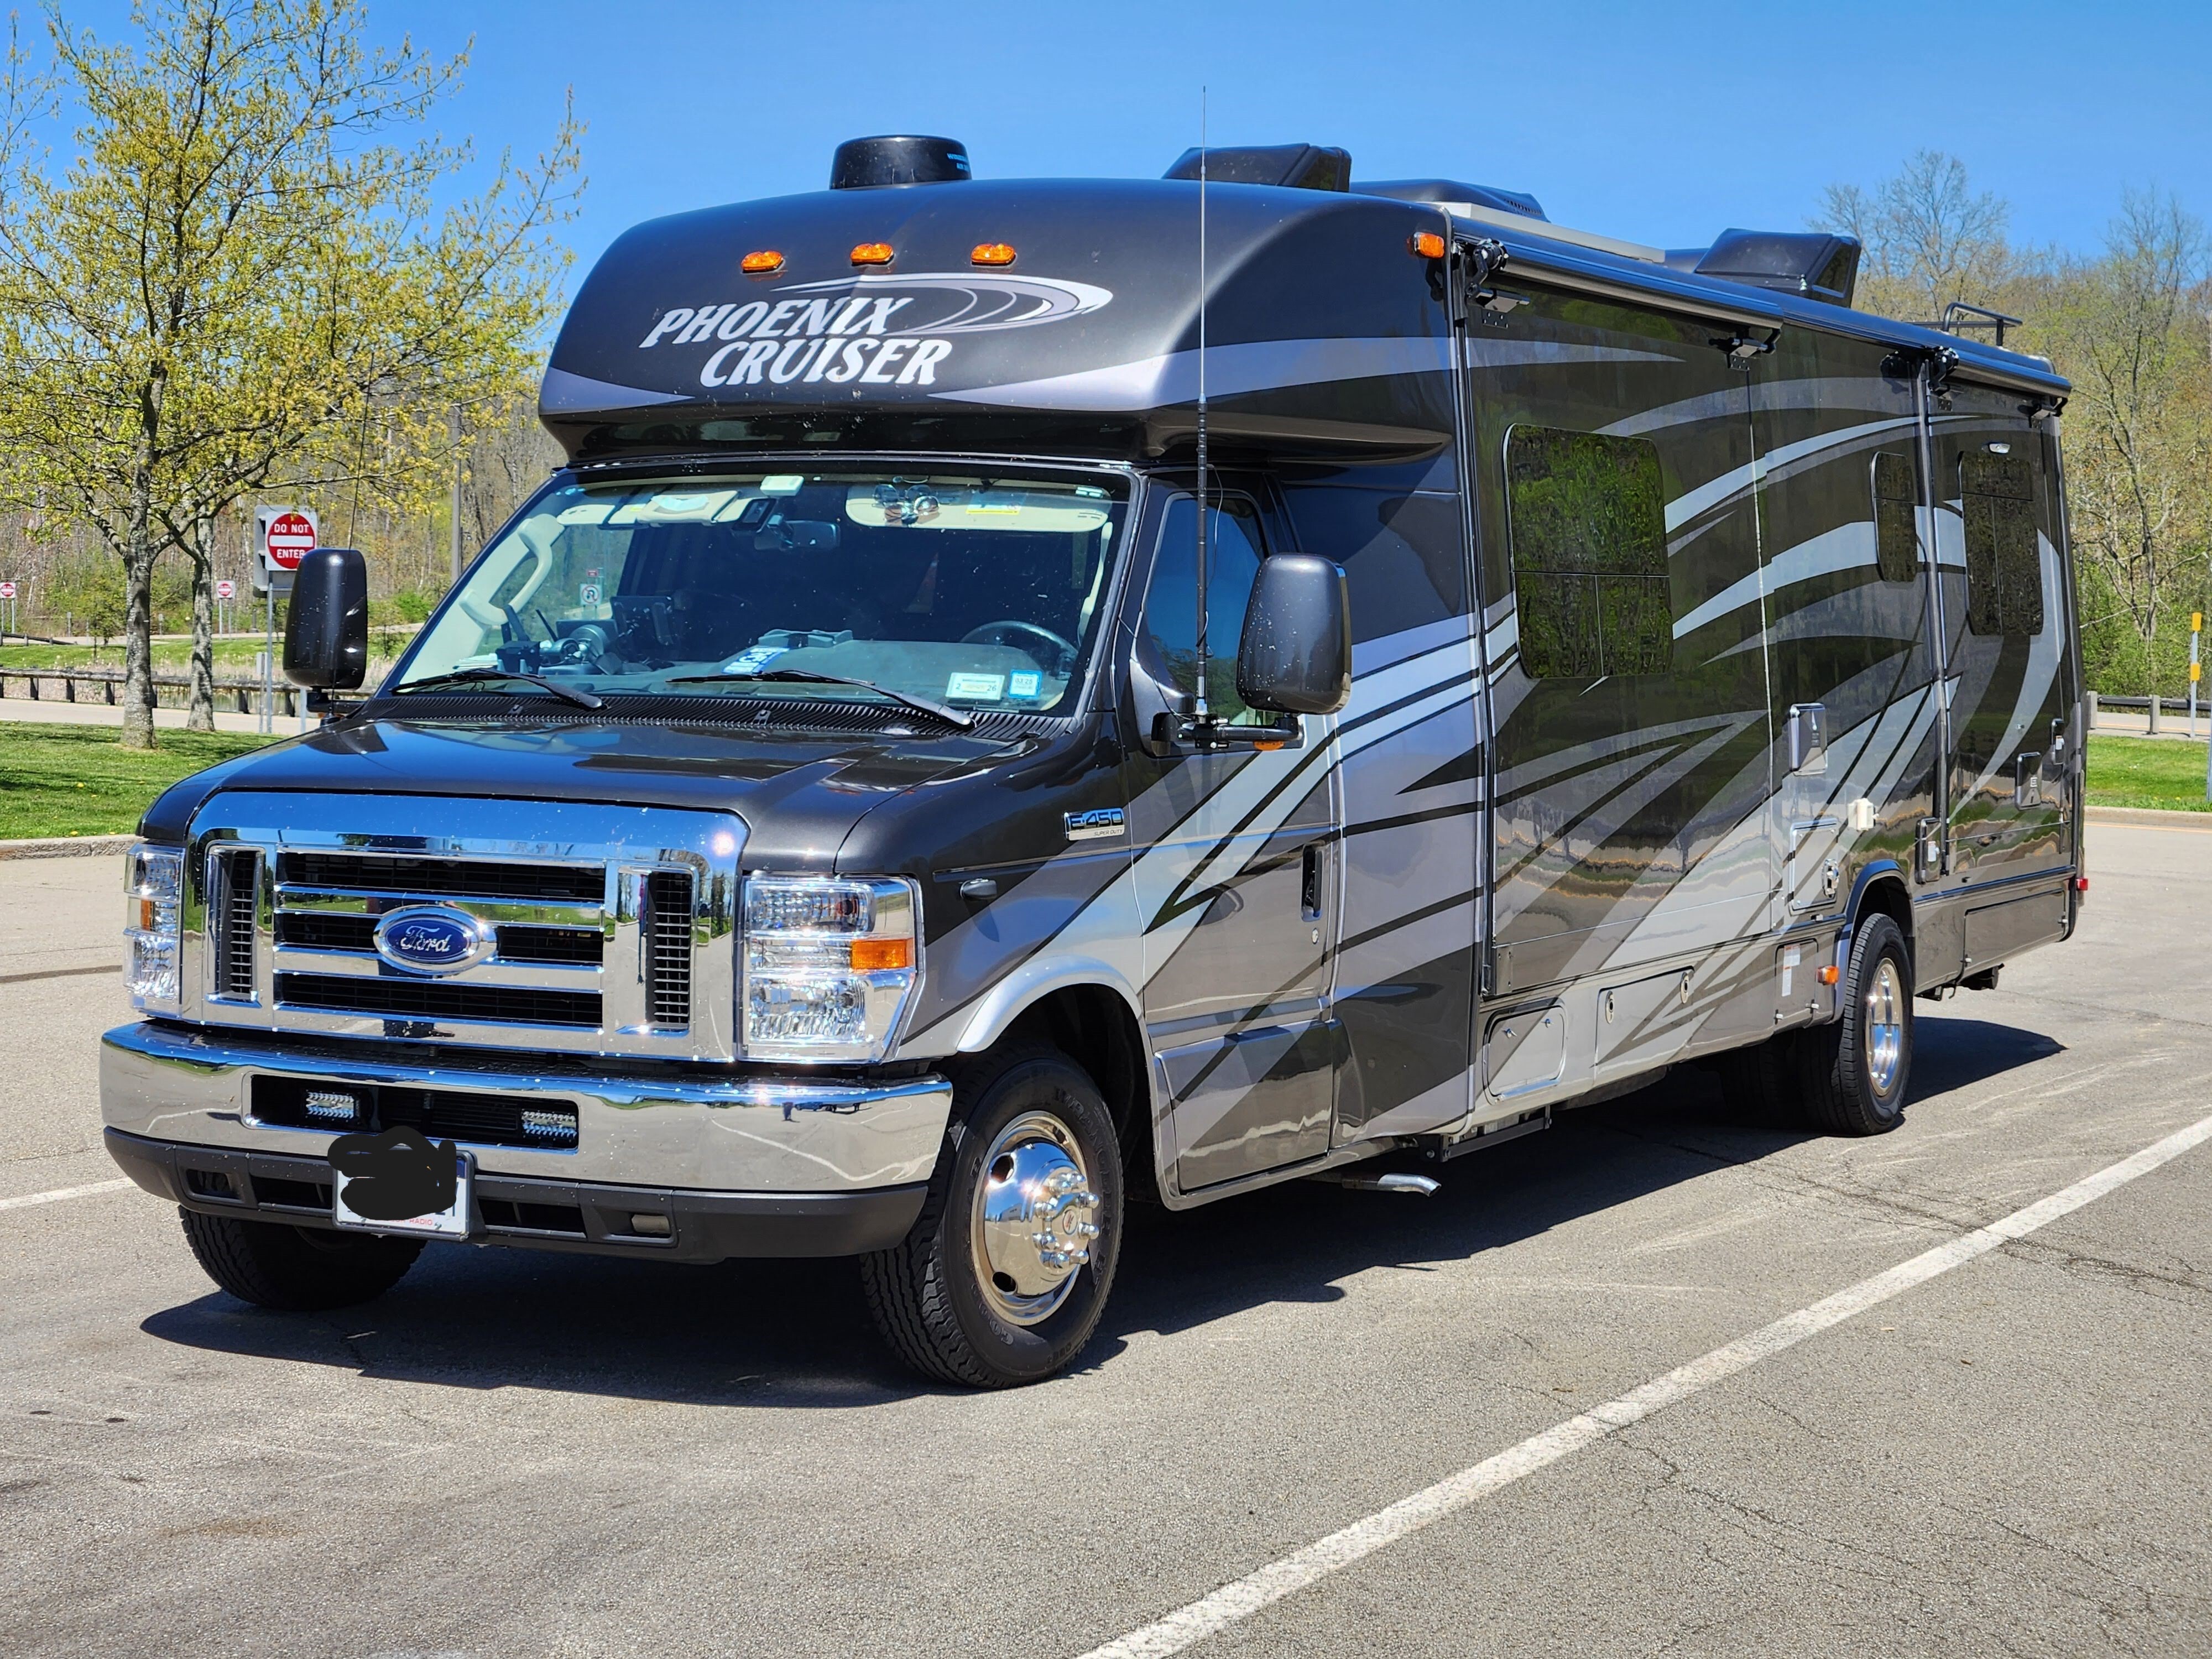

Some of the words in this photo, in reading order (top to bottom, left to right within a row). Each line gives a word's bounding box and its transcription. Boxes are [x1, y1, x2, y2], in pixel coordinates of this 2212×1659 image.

[639, 296, 914, 348] PHOENIX
[699, 338, 953, 387] CRUISER
[274, 524, 286, 533] DO
[291, 524, 309, 533] NOT
[276, 549, 305, 559] ENTER
[400, 925, 452, 952] Ford
